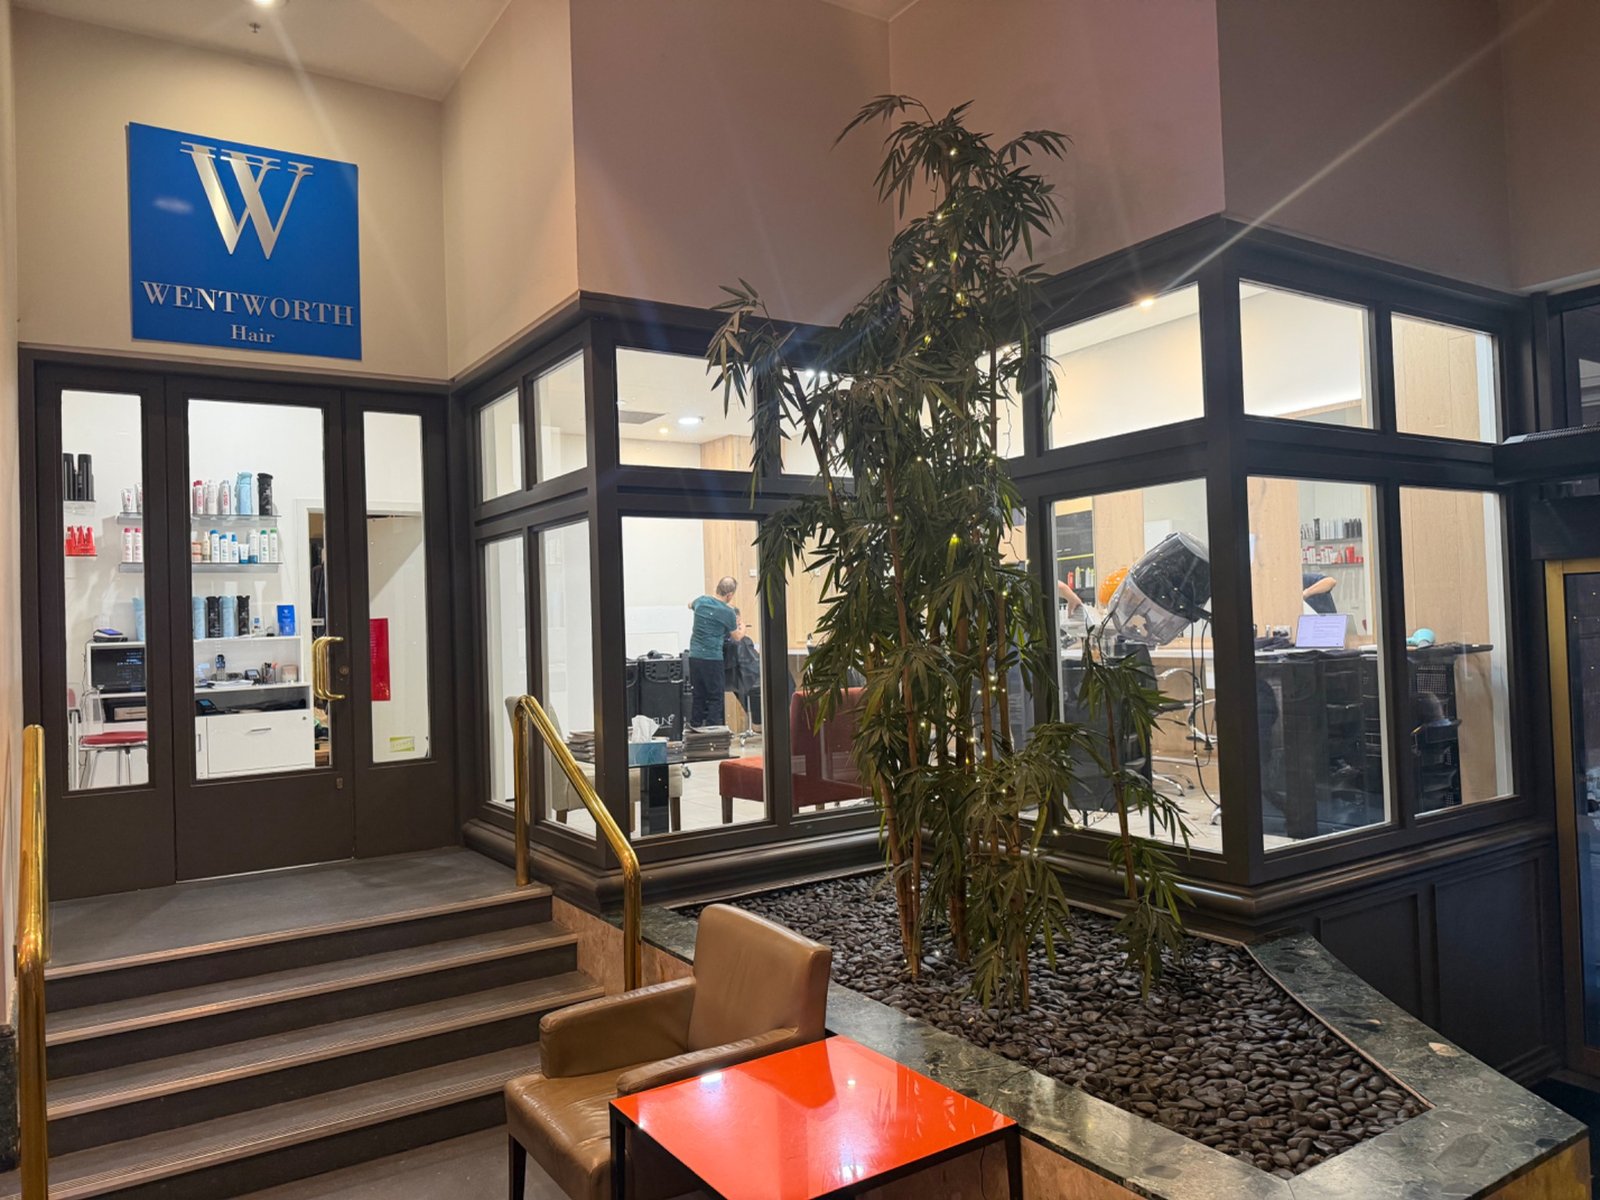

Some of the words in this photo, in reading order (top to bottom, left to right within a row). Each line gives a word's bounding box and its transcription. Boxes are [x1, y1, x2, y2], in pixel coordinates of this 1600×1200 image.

[180, 141, 313, 260] W
[140, 280, 354, 326] WENTWORTH
[230, 324, 275, 344] Hair
